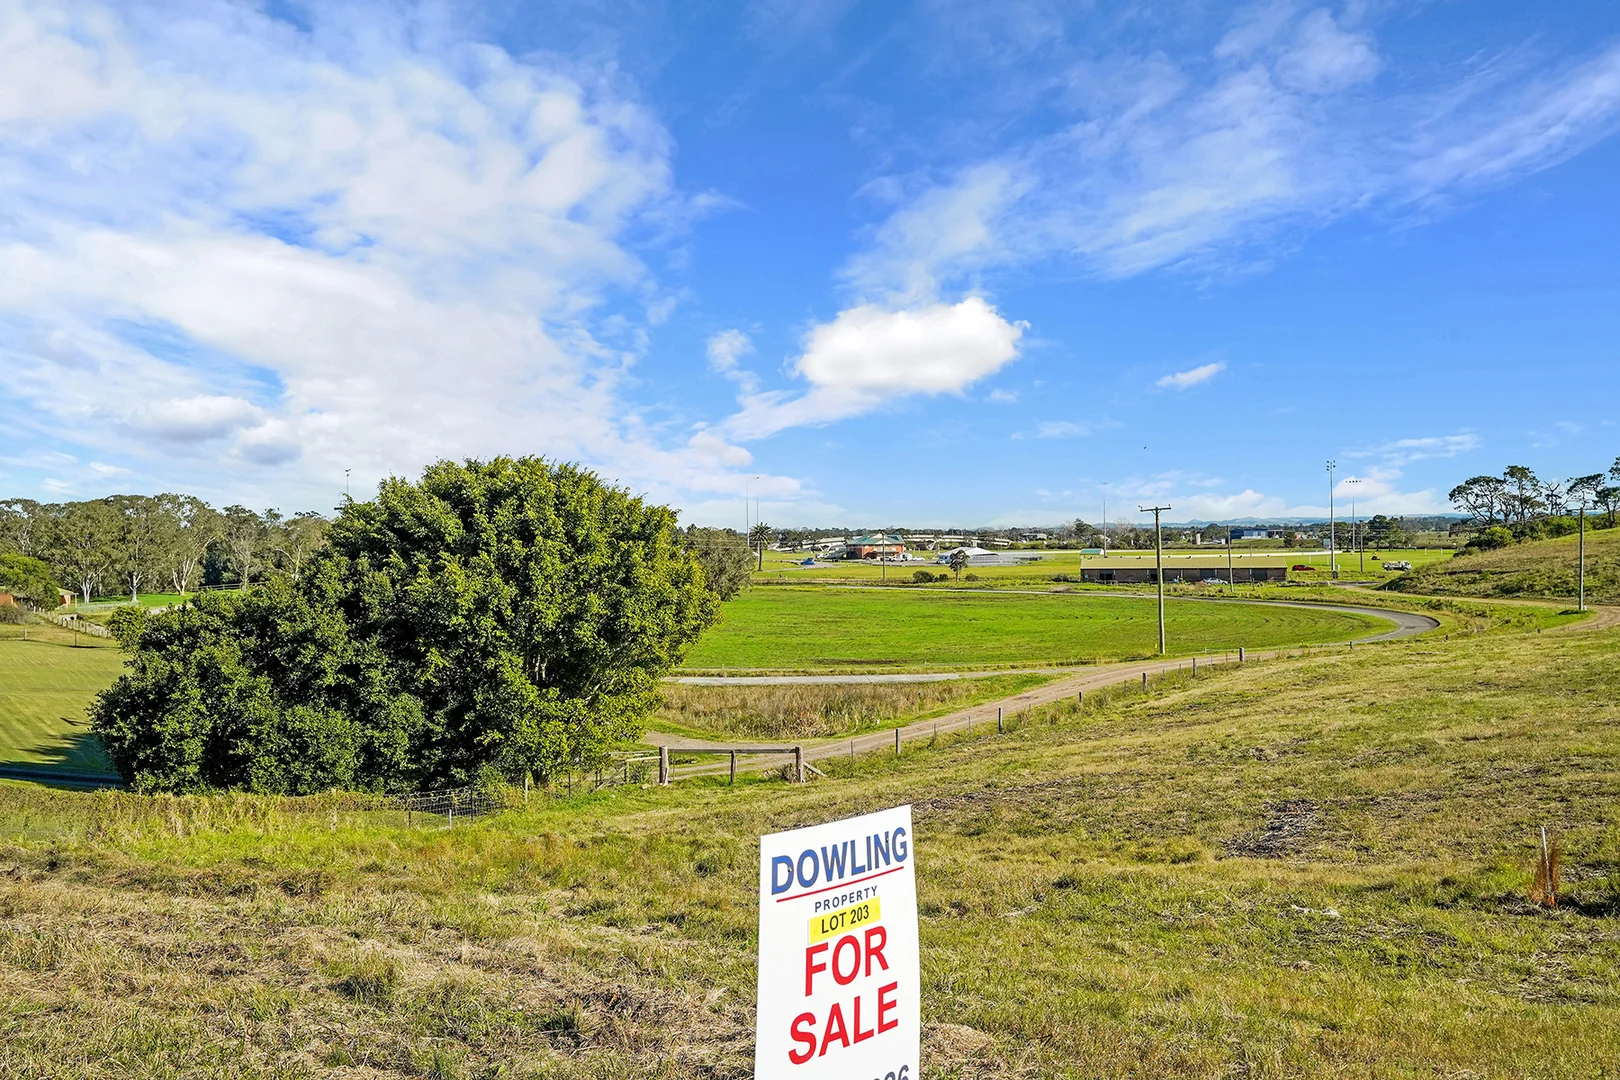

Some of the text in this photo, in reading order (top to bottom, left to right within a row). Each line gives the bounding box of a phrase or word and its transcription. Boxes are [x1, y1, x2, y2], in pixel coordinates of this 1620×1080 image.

[771, 827, 908, 895] DOWLING
[815, 885, 877, 913] PROPERTY
[821, 904, 869, 934] LOT 203
[805, 926, 889, 997] FOR
[788, 981, 898, 1065] SALE
